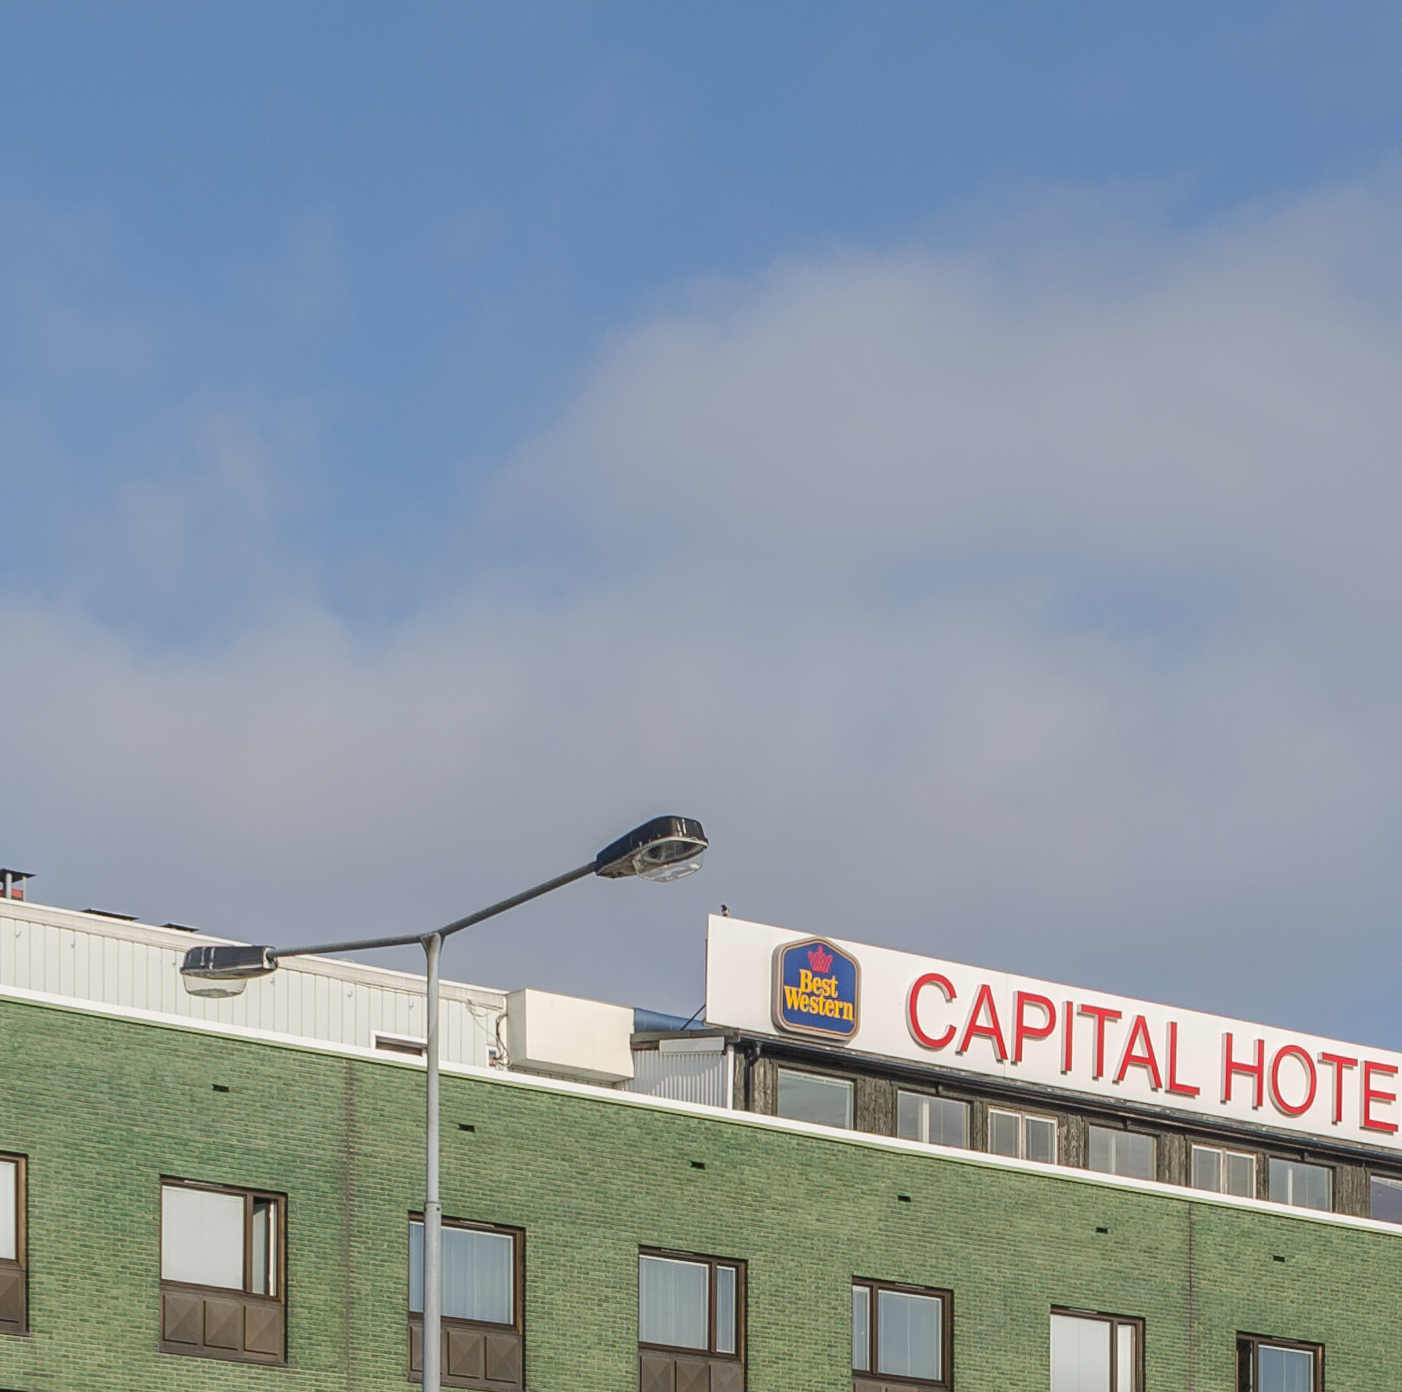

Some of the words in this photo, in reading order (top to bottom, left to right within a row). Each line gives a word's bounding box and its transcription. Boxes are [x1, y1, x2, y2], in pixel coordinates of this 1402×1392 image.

[799, 968, 838, 998] Best
[783, 985, 854, 1021] Western
[907, 973, 1201, 1097] CAPITAL
